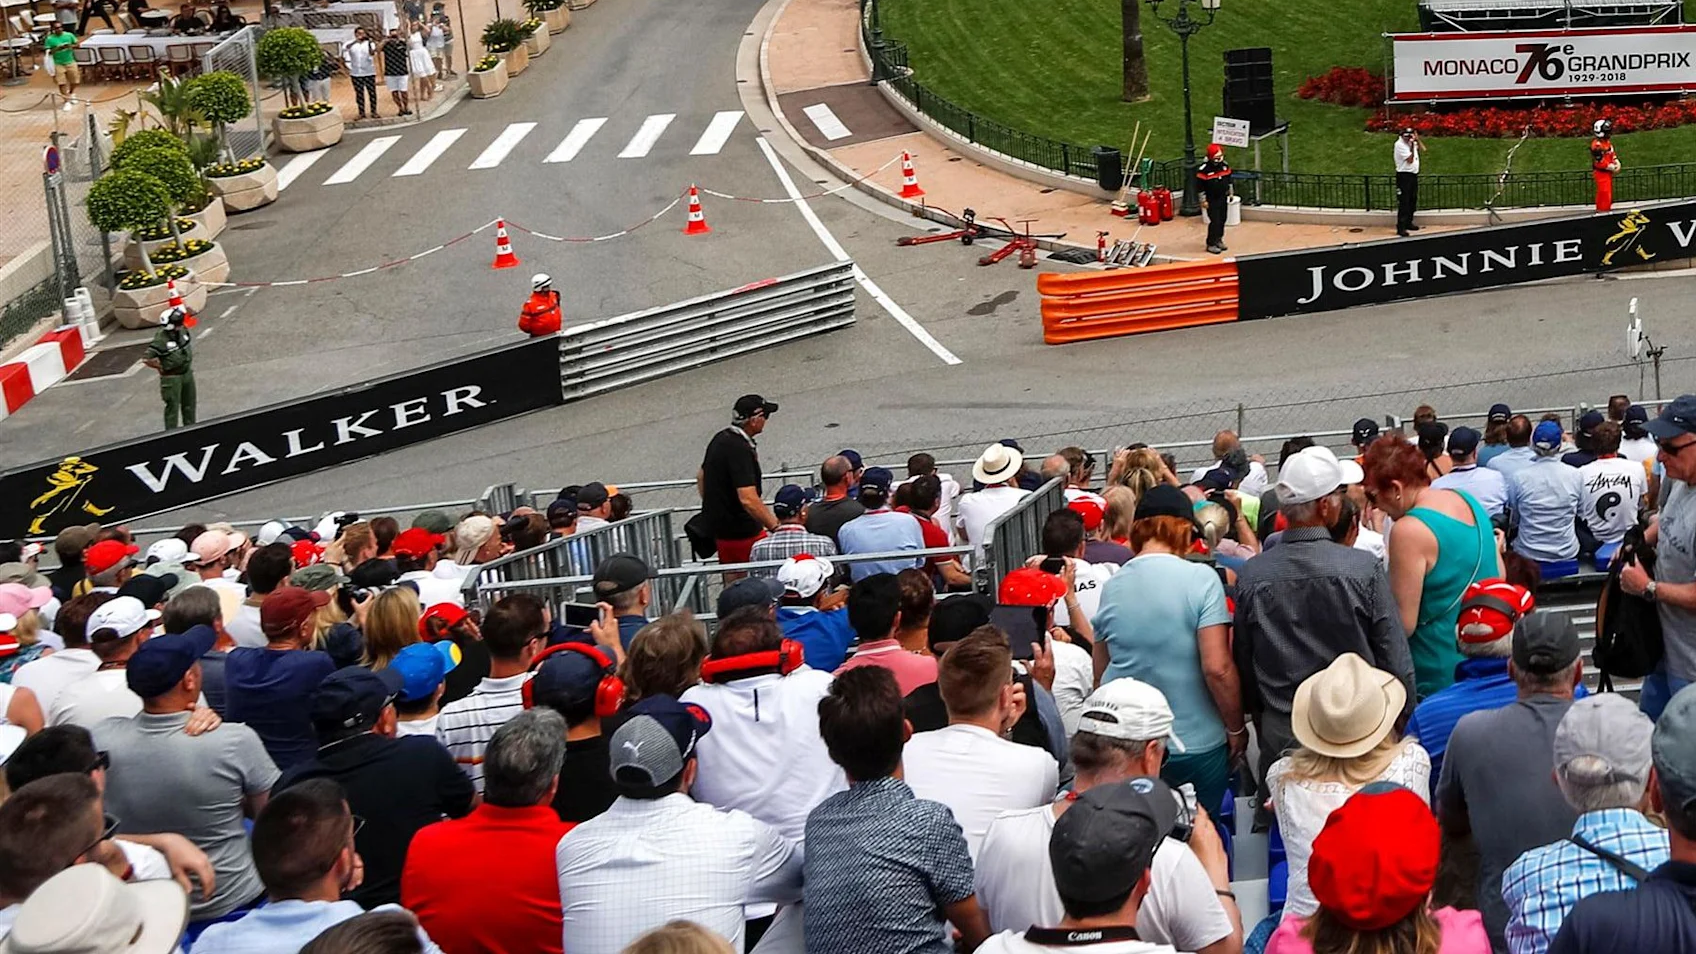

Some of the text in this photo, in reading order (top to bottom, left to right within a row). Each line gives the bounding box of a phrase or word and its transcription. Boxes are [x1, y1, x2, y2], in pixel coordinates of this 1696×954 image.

[1424, 59, 1518, 76] MONACO
[1569, 73, 1626, 83] 1929-2018
[1297, 238, 1584, 304] JOHNNIE
[125, 385, 488, 494] WALKER
[1067, 930, 1103, 942] Canon
